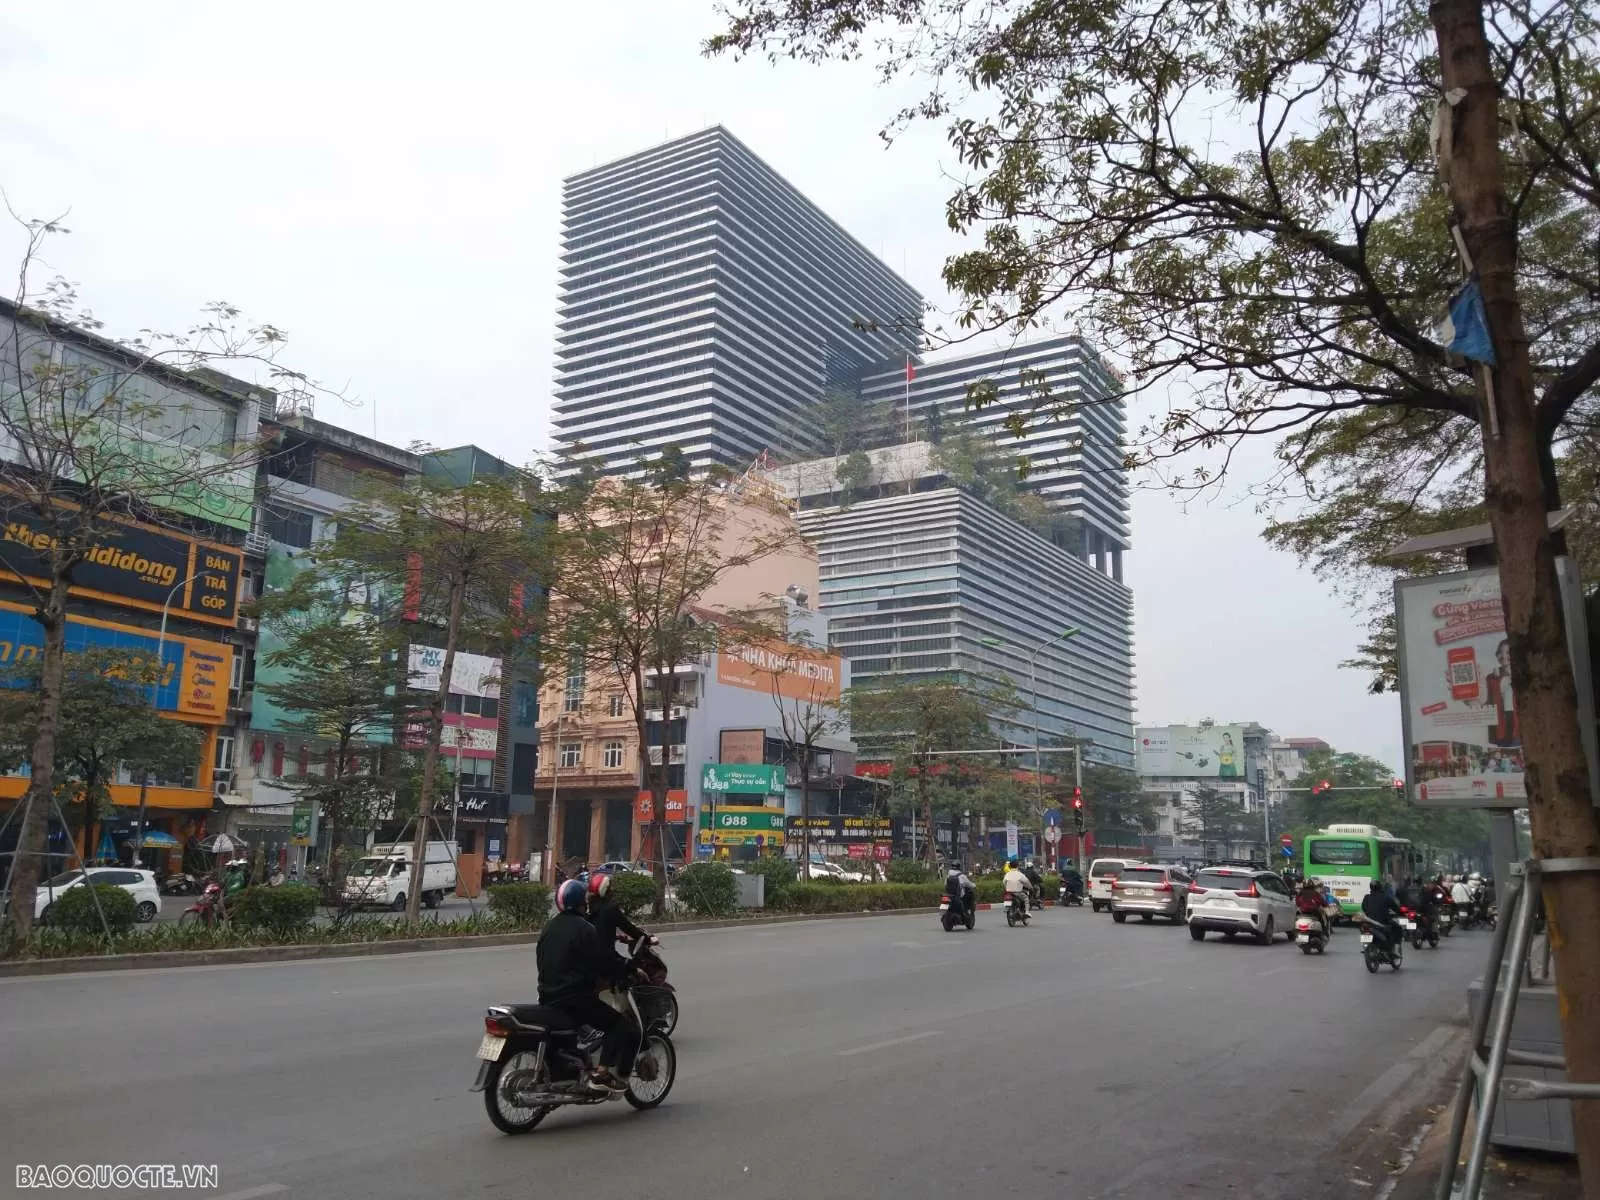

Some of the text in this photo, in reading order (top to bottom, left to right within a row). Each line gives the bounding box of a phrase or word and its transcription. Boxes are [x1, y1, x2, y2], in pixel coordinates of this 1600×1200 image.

[4, 521, 178, 587] theididong
[742, 645, 766, 668] NHA
[466, 797, 488, 811] Hut
[665, 800, 683, 810] dita
